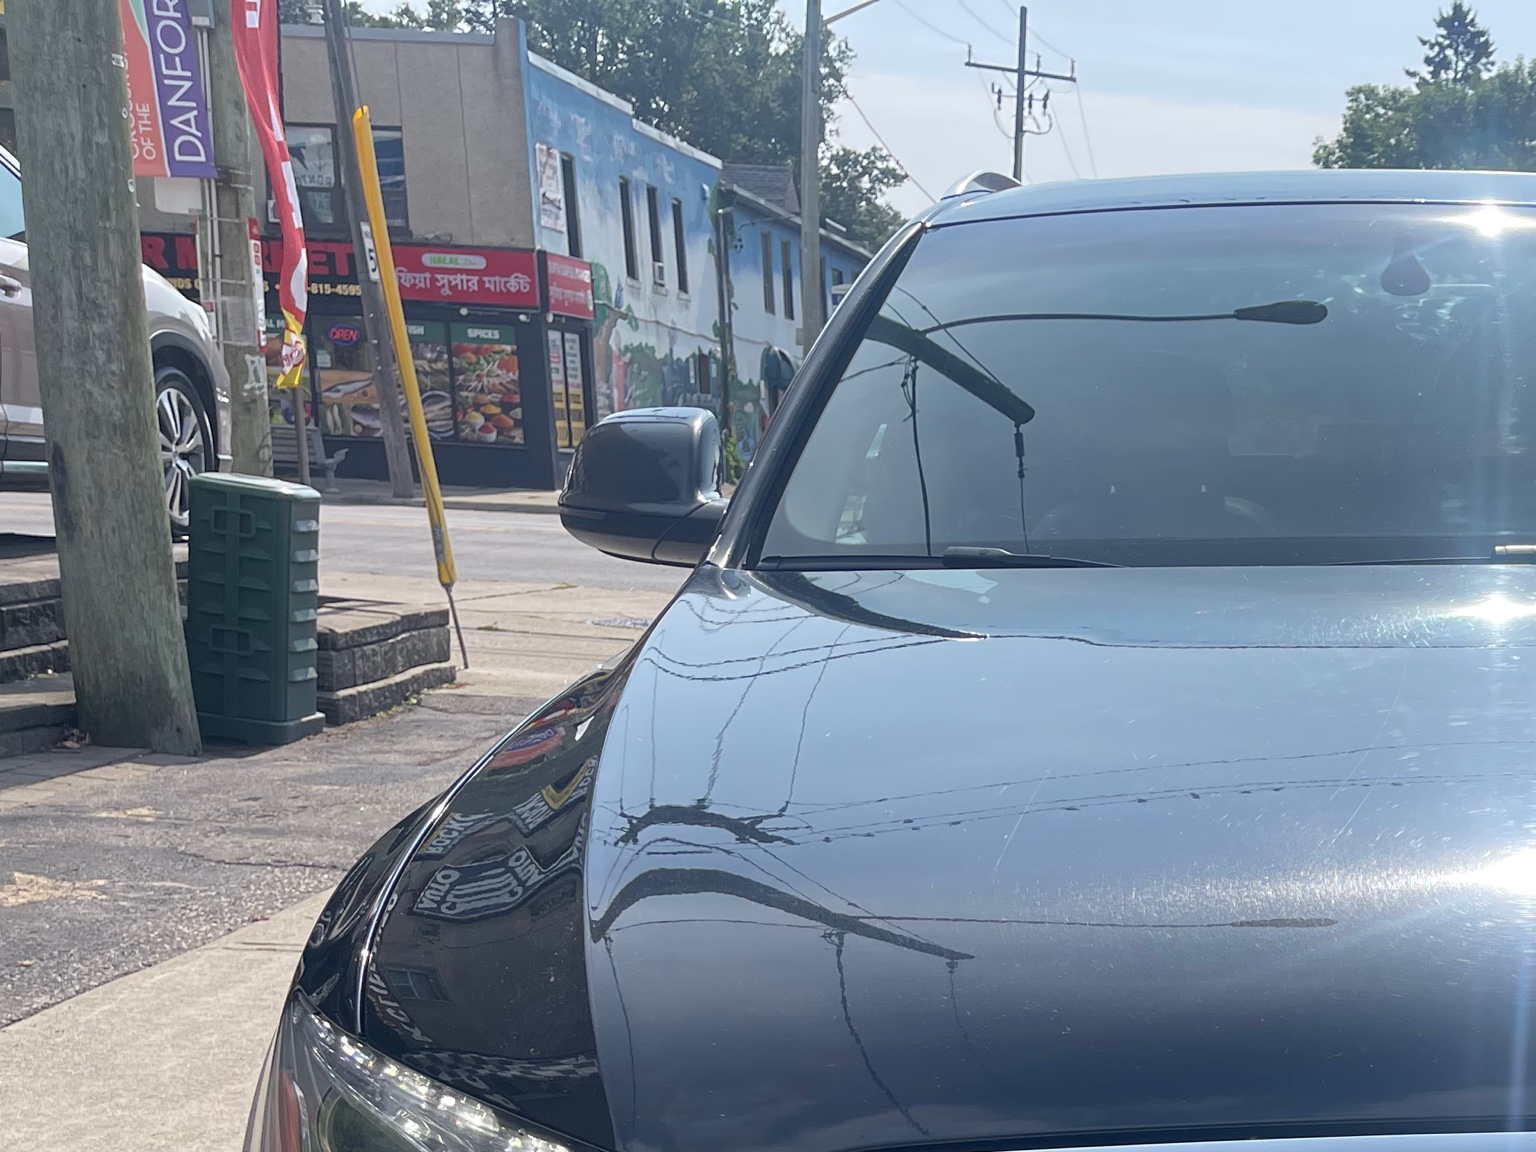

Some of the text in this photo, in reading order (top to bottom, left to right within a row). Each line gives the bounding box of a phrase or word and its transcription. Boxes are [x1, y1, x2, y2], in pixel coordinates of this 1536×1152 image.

[136, 102, 156, 161] OF THE
[330, 327, 358, 342] OPEN
[467, 328, 500, 340] SPICES
